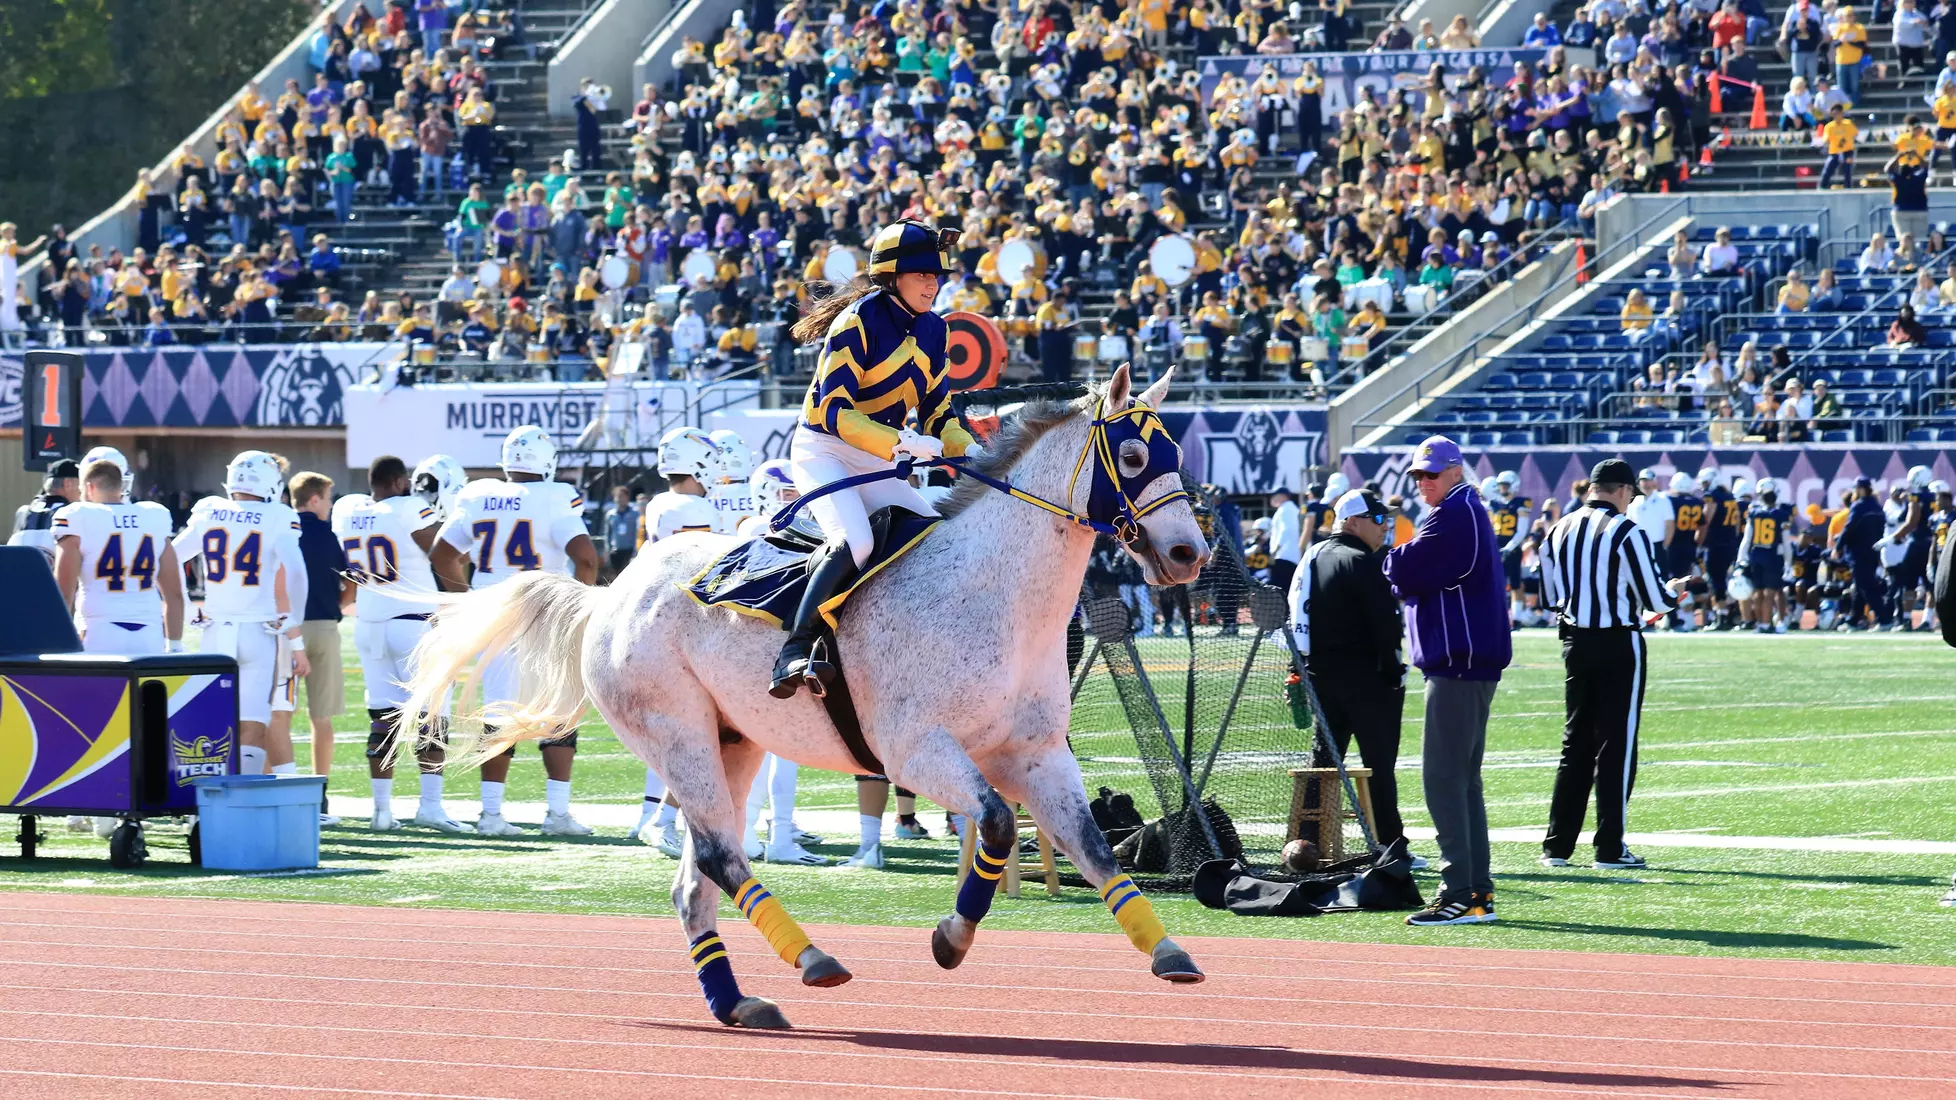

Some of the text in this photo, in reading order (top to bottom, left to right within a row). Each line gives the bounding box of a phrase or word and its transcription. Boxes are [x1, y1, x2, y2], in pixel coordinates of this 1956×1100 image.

[1357, 55, 1408, 70] YOUR
[41, 364, 60, 427] 1
[483, 497, 521, 511] ADAMS
[708, 498, 754, 511] APLES
[113, 515, 139, 529] LEE
[211, 508, 262, 525] MOYERS
[352, 516, 376, 529] HUFF
[1753, 518, 1776, 545] 16
[472, 518, 543, 573] 74
[95, 531, 155, 592] 44
[203, 527, 262, 587] 84
[343, 534, 399, 586] 50
[177, 763, 226, 778] TECH
